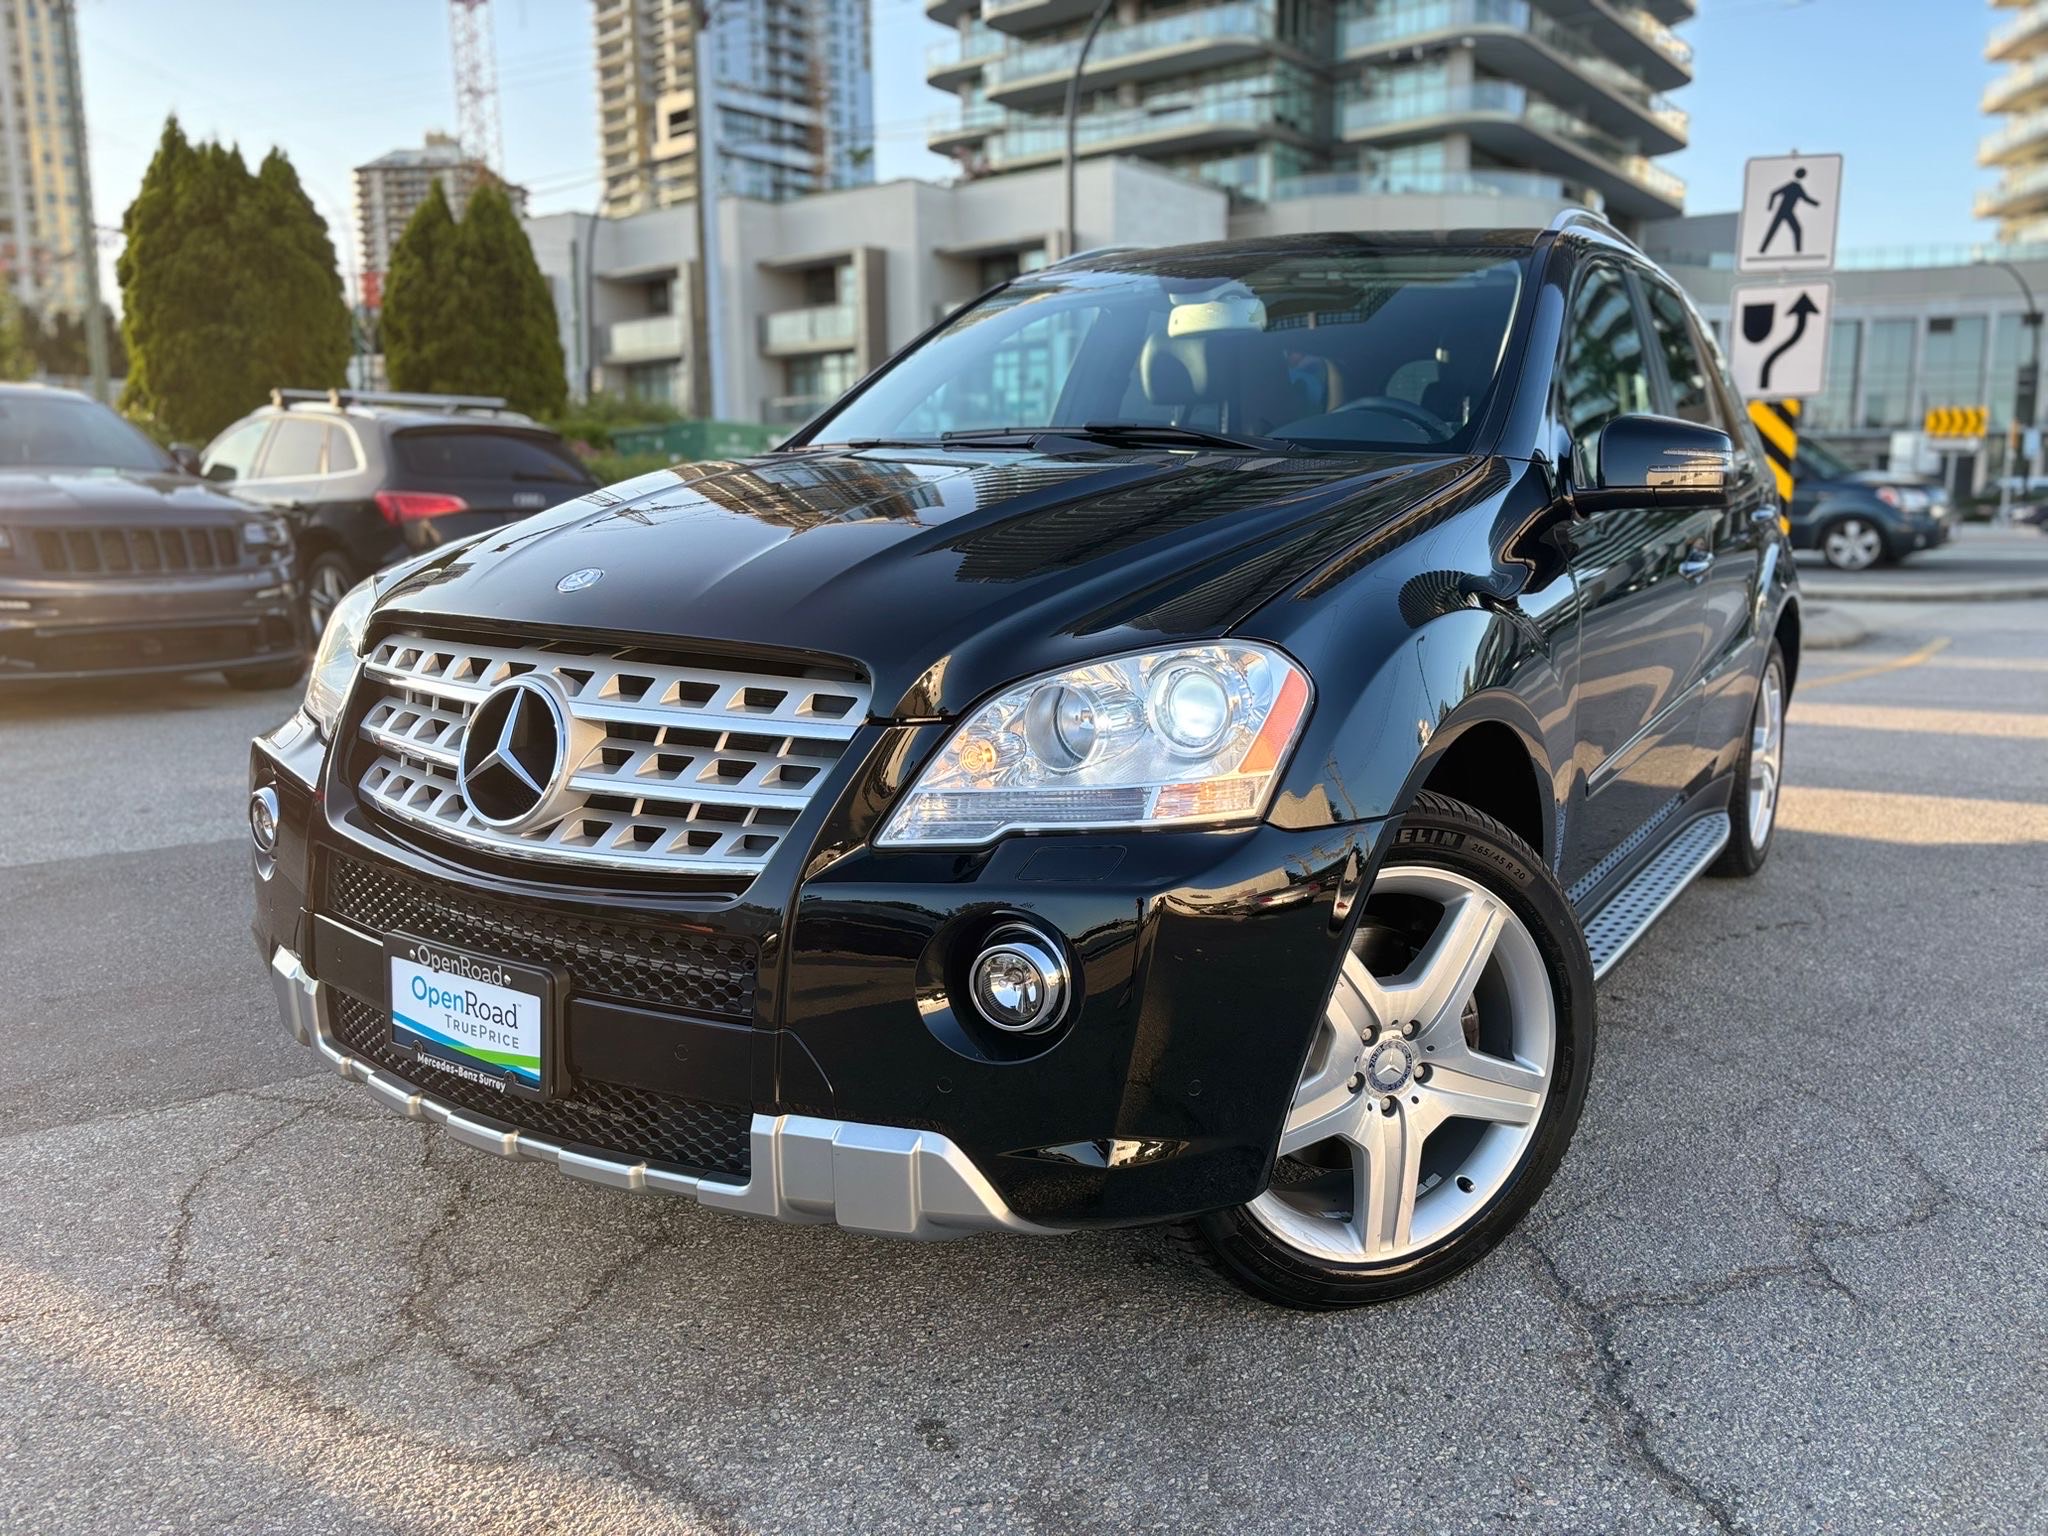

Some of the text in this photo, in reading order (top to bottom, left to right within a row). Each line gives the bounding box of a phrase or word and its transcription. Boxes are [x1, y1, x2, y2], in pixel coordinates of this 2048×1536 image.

[1472, 843, 1506, 865] 265/45
[1505, 862, 1514, 871] R
[1513, 868, 1526, 880] 20
[417, 944, 504, 986] OpenRoad
[411, 975, 519, 1030] OpenRoad
[417, 1052, 506, 1094] Mercedes-Benz Surrey
